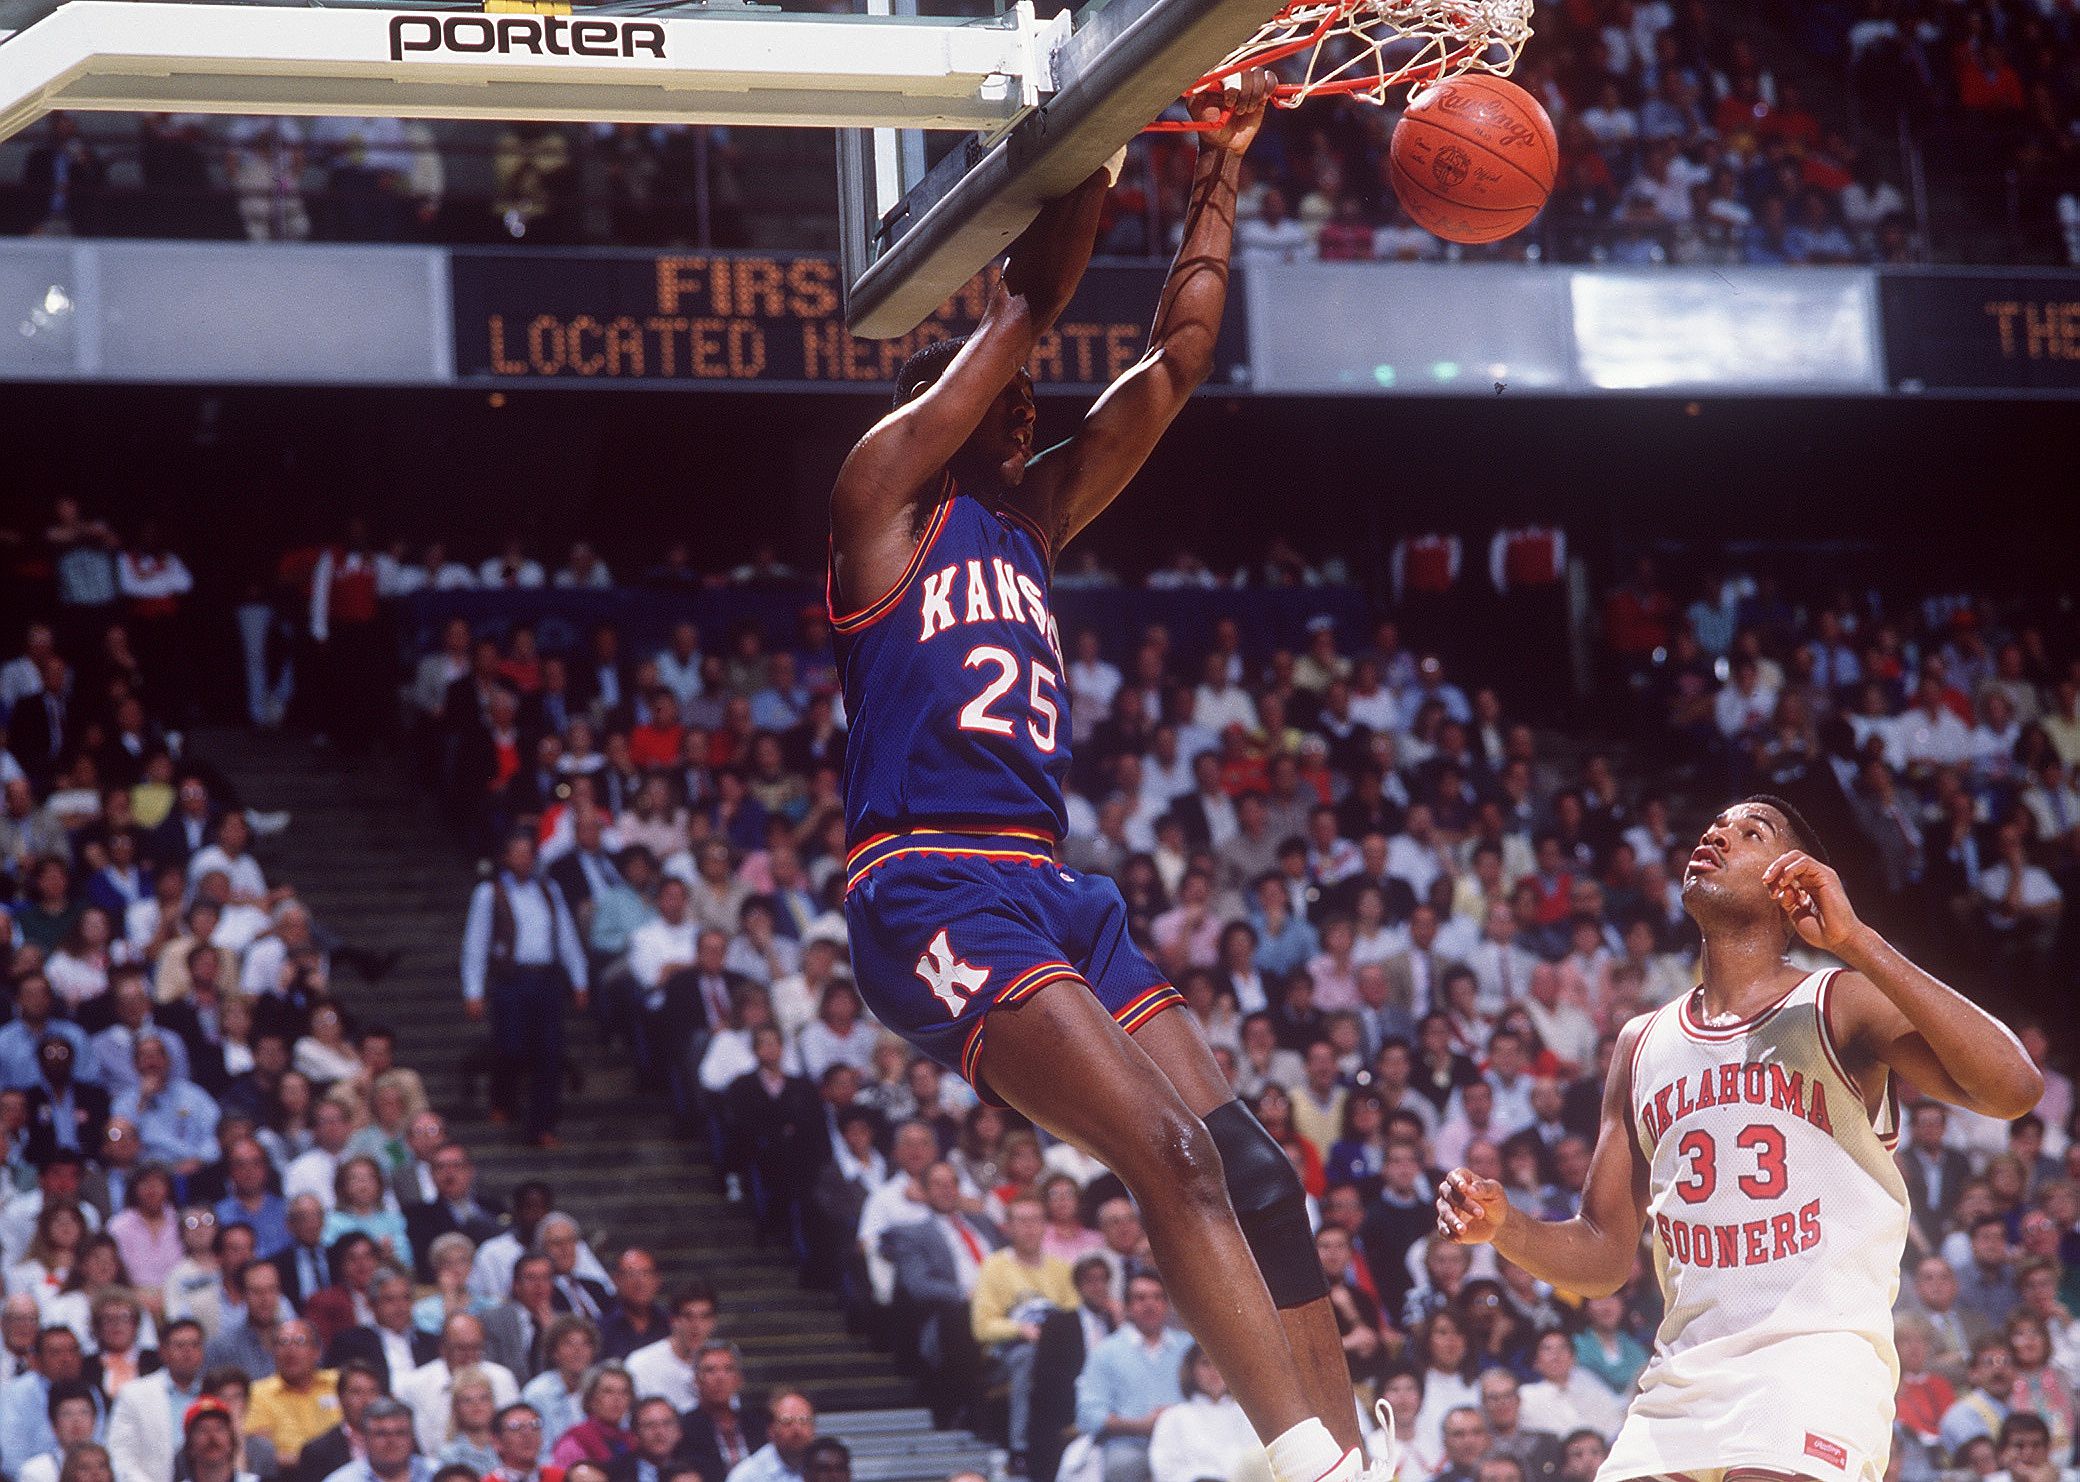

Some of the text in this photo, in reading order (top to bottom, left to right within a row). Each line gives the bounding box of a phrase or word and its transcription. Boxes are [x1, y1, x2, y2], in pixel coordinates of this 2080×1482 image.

[655, 255, 839, 318] FIRS
[487, 314, 767, 379] LOCATED
[1028, 322, 1141, 383] ATE
[957, 643, 1059, 754] 25
[914, 927, 993, 1020] K
[1642, 1062, 1834, 1149] OKLAHOMA
[1675, 1123, 1788, 1206] 33
[1656, 1197, 1822, 1269] SOONERS
